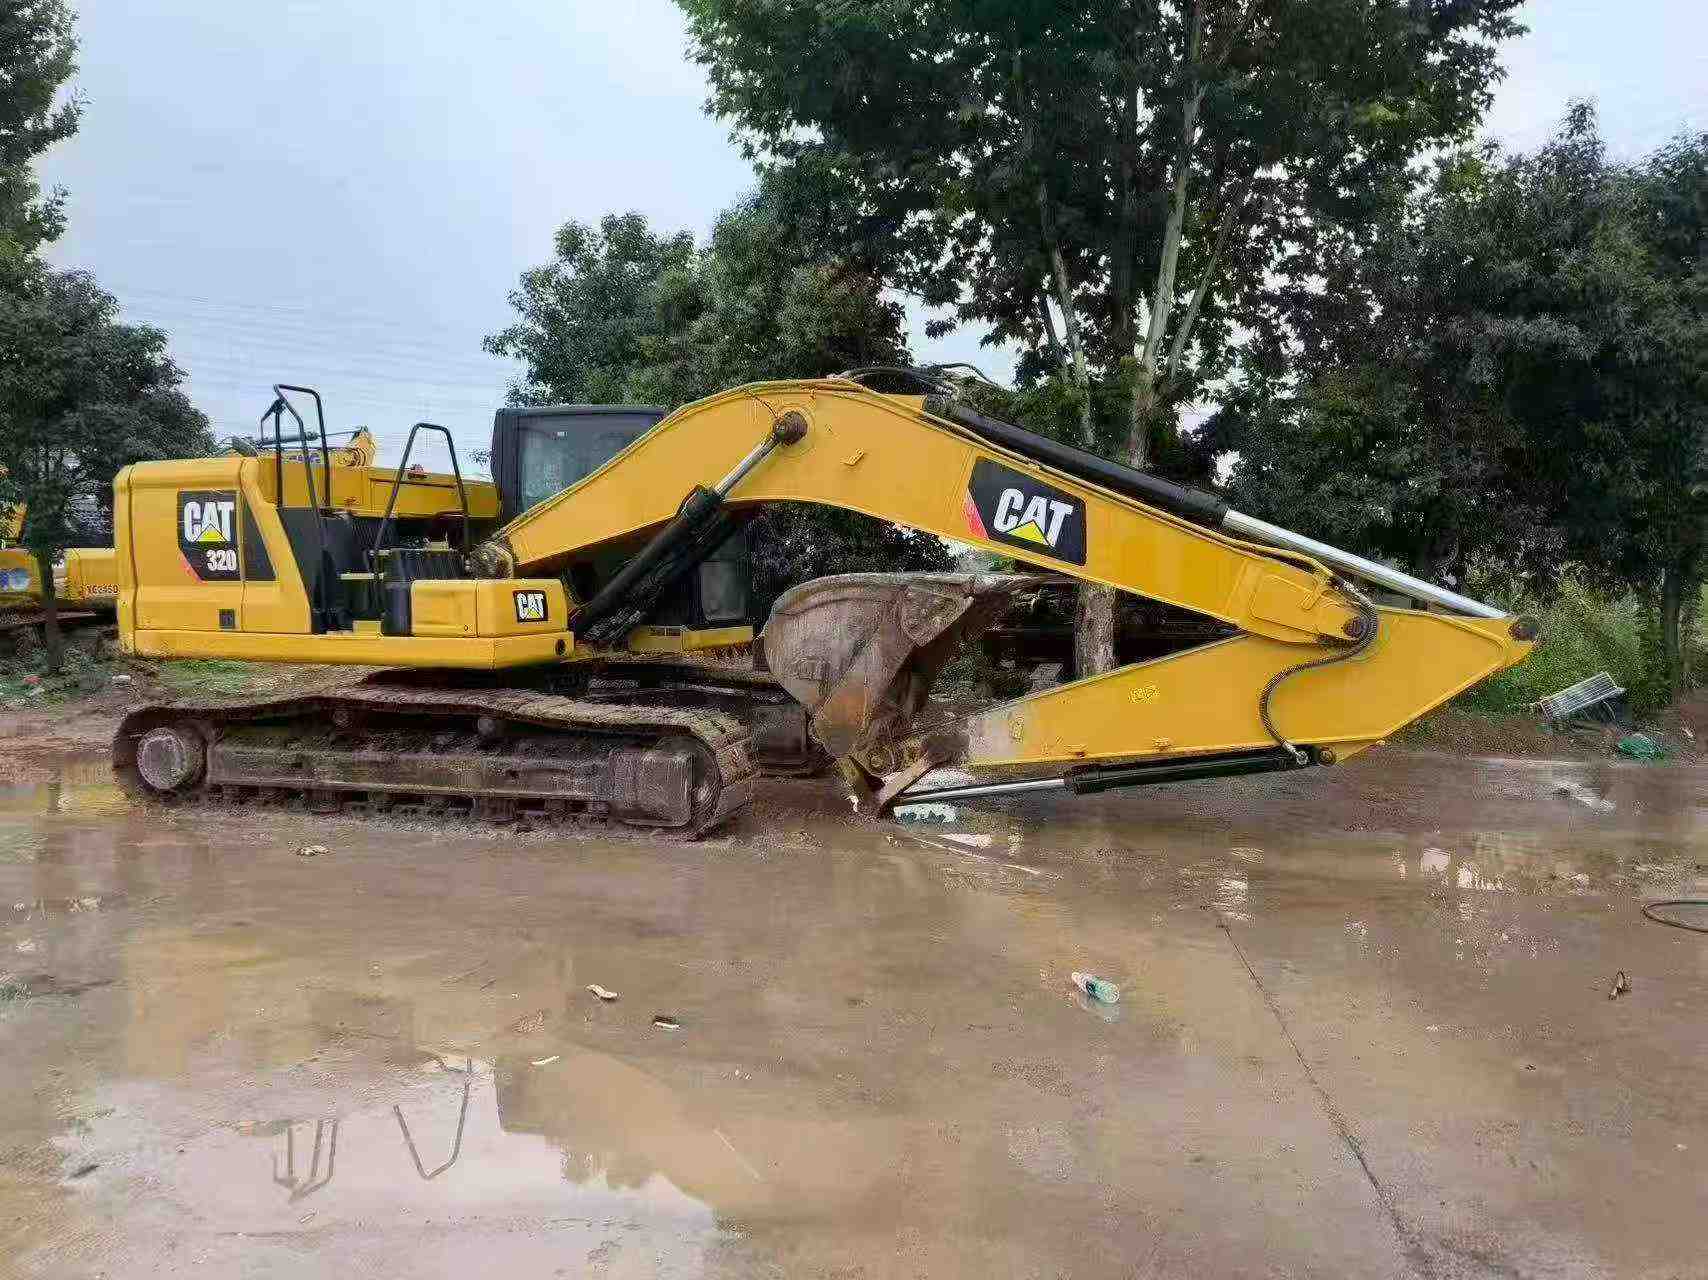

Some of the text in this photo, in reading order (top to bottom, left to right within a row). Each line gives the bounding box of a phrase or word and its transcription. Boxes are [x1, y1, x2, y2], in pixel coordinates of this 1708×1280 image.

[184, 501, 234, 541] CAT
[993, 488, 1074, 547] CAT
[206, 549, 236, 571] 320
[516, 593, 544, 619] CAT
